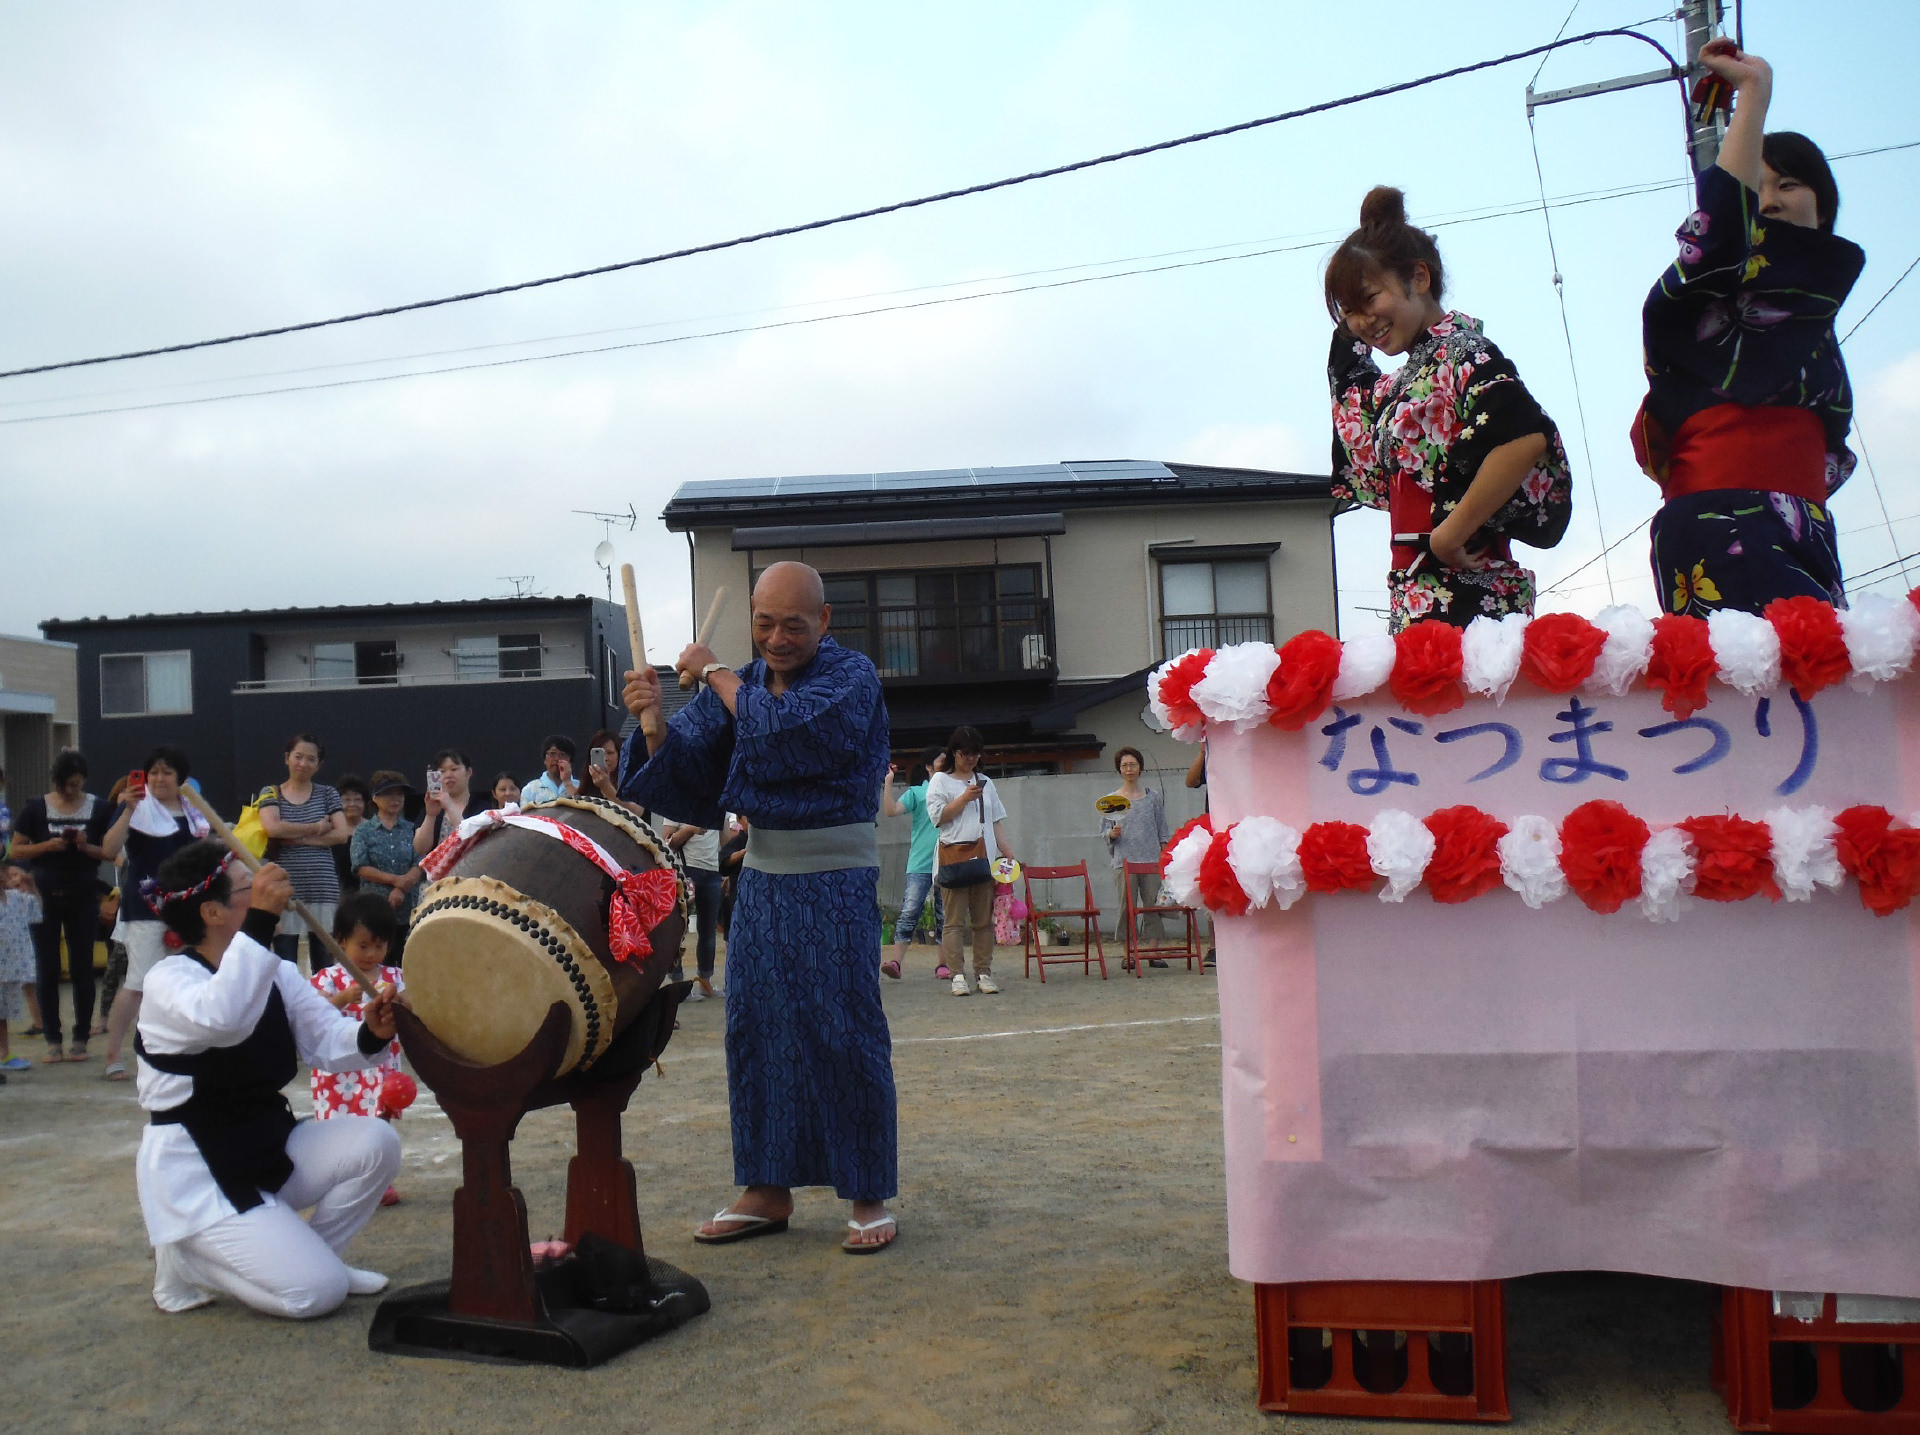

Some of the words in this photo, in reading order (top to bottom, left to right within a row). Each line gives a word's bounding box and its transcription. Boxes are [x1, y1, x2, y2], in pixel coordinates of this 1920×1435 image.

[1318, 687, 1818, 796] なつまつり
